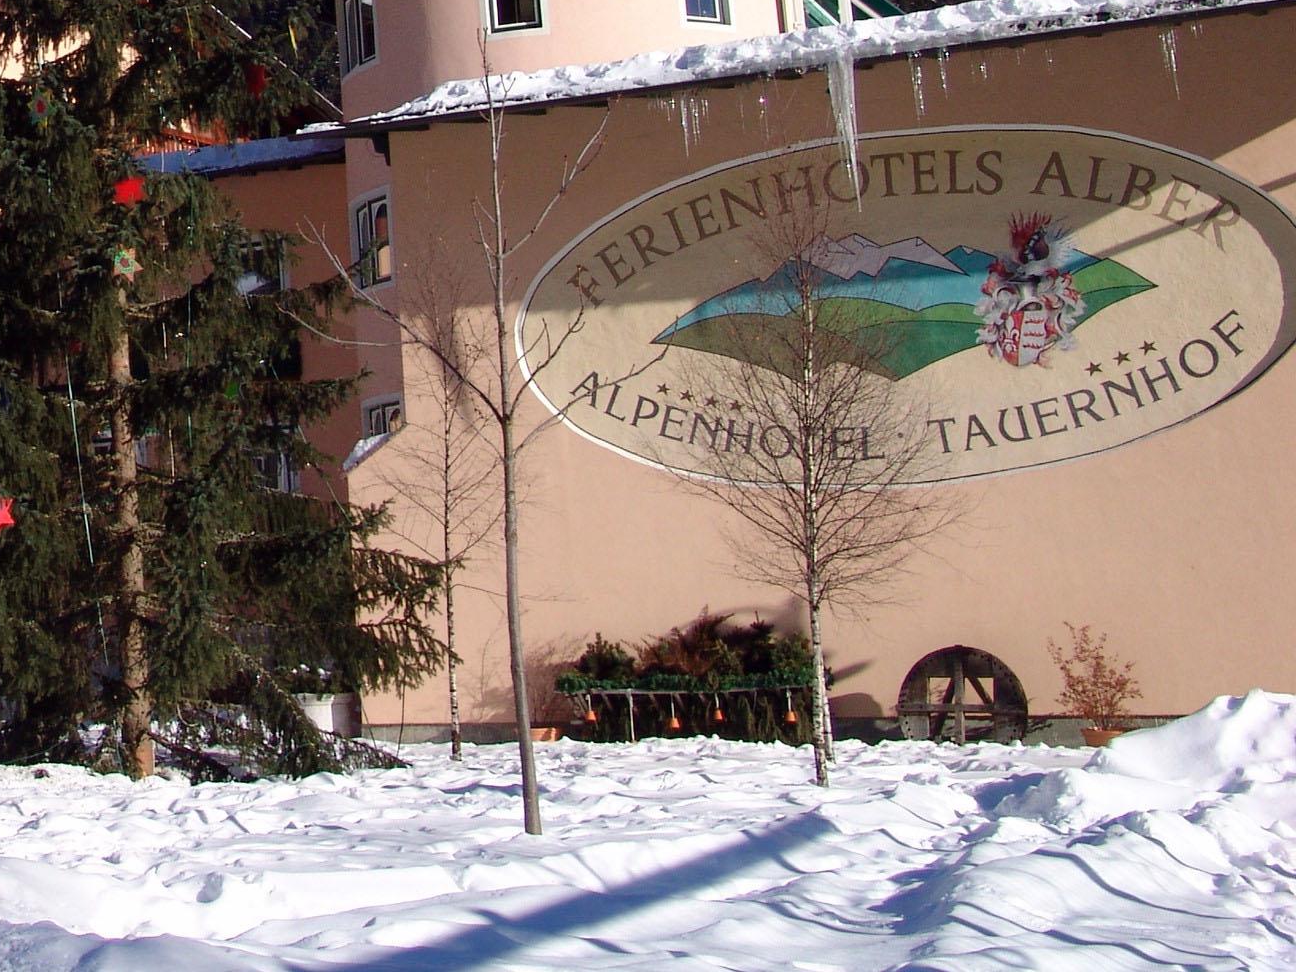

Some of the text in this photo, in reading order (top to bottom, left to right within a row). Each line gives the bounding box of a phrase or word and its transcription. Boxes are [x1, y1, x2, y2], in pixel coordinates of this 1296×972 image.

[567, 149, 1242, 309] FERIENHOTELS ALBER
[927, 308, 1245, 454] TAUERNHOF
